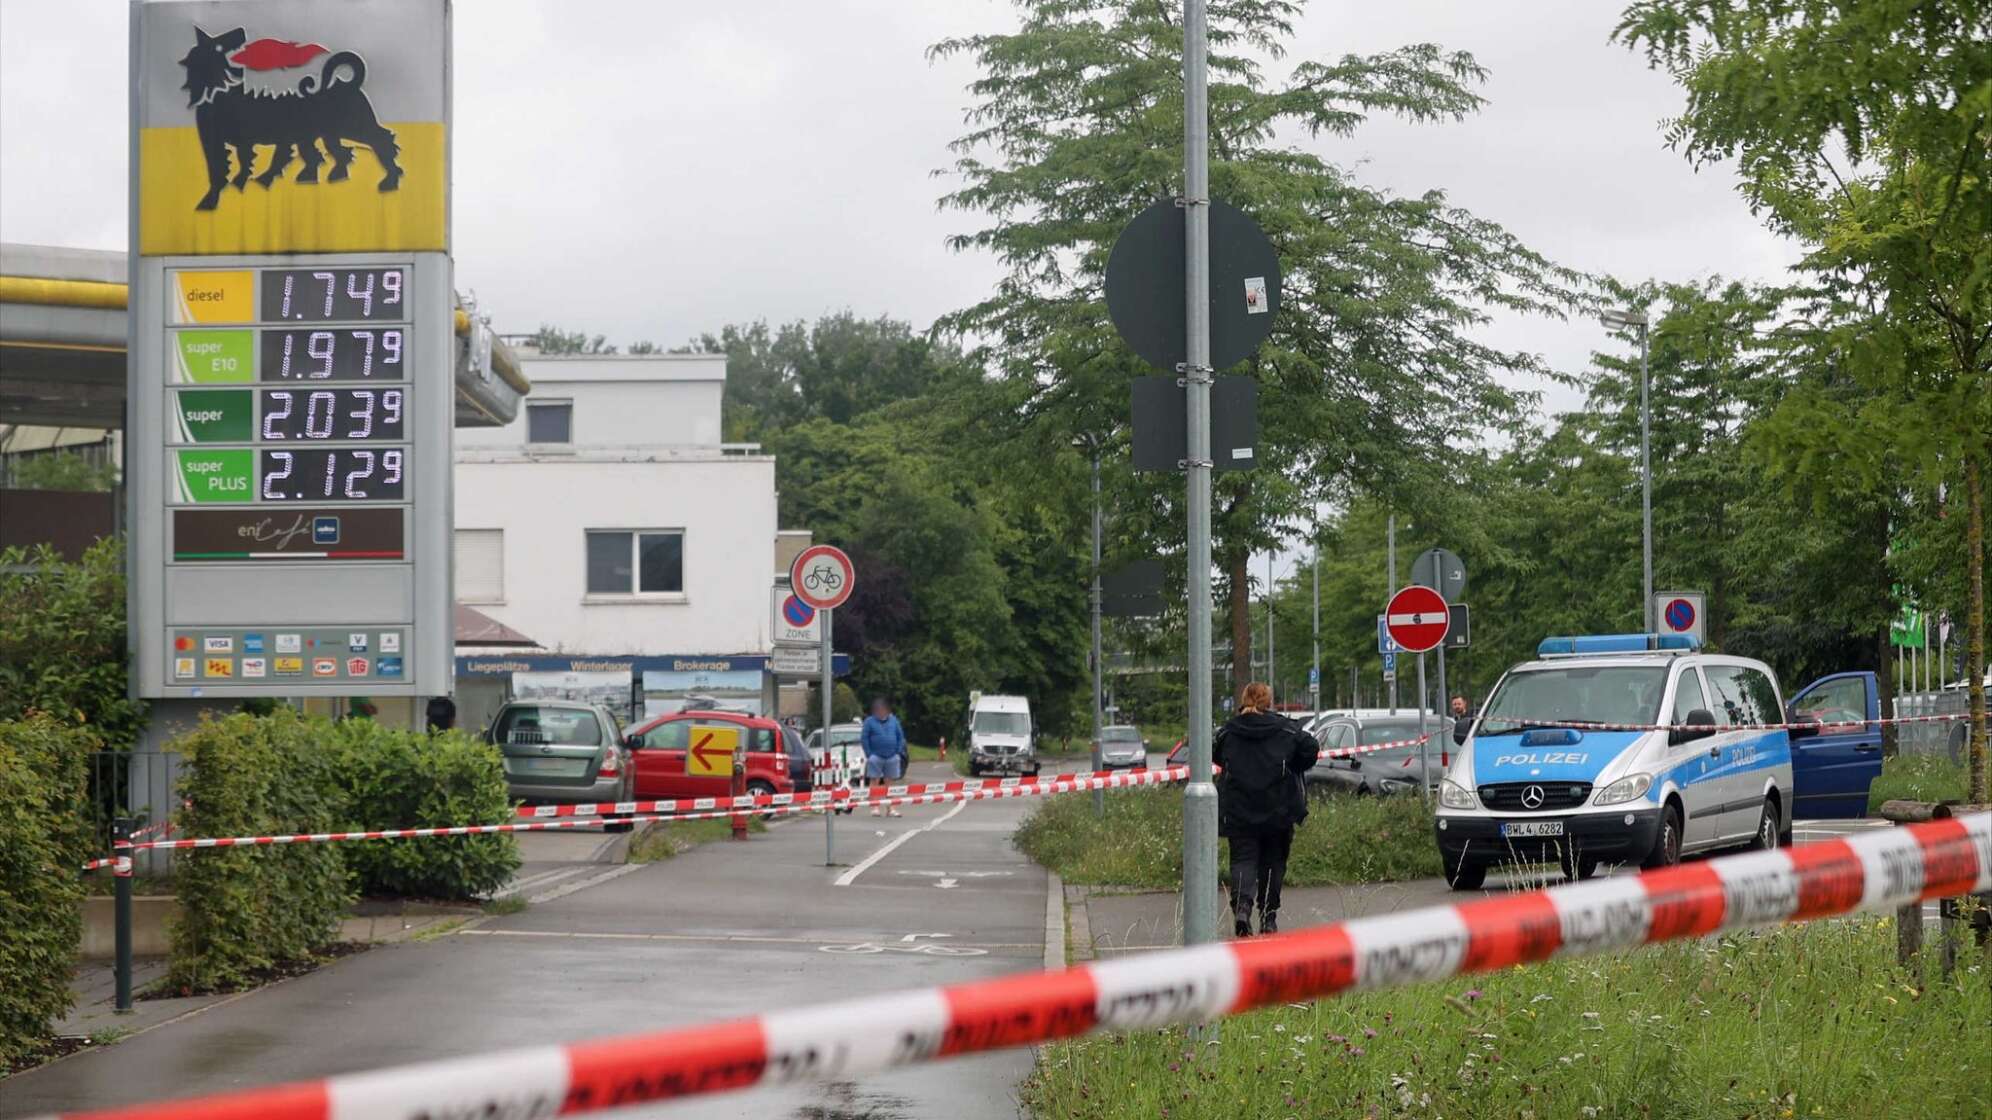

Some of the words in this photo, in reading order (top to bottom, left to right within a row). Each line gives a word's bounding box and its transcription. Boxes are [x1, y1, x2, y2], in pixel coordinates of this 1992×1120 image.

[187, 288, 224, 301] diesel
[186, 343, 223, 356] super
[212, 358, 237, 371] E10
[186, 410, 223, 424] super
[186, 462, 223, 475] super
[208, 477, 247, 490] PLUS
[785, 629, 811, 639] ZONE
[209, 640, 229, 648] VISA
[674, 660, 730, 672] Brokerage
[1494, 752, 1589, 767] POLIZEI
